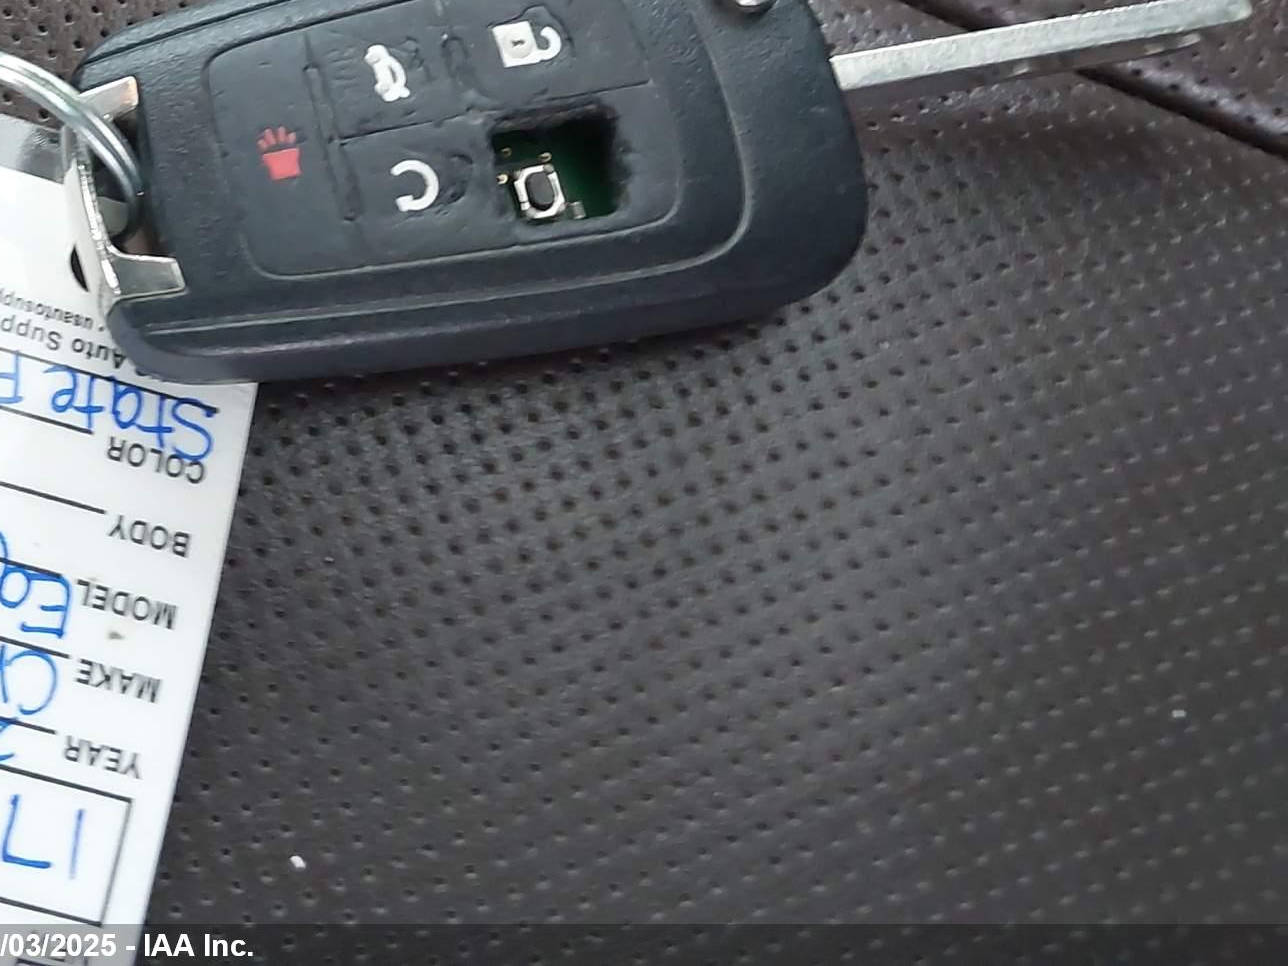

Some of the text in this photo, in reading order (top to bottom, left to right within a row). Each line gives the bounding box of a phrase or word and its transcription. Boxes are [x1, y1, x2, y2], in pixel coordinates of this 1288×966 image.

[71, 338, 126, 371] Auto
[43, 365, 215, 461] State
[106, 435, 208, 484] COLOR
[108, 514, 192, 558] BODY
[77, 577, 180, 631] MODEL
[73, 659, 163, 704] MAKE
[63, 736, 143, 779] YEAR
